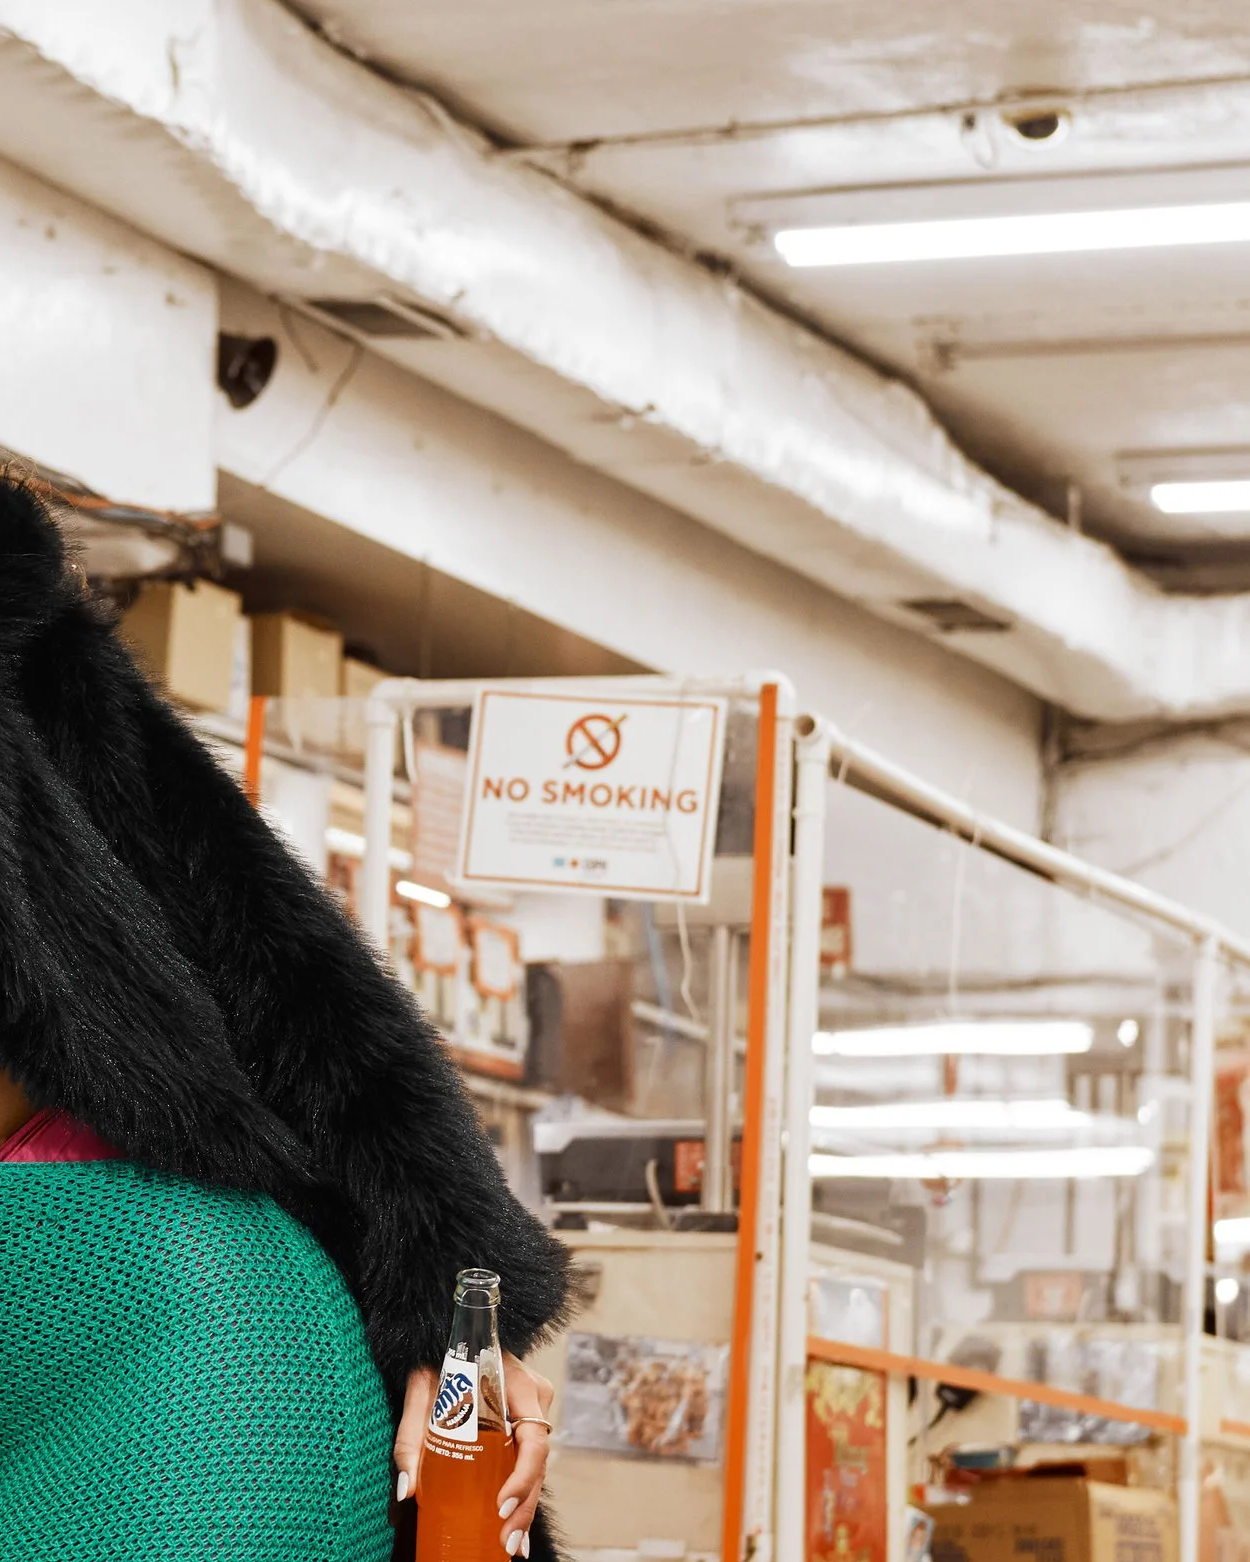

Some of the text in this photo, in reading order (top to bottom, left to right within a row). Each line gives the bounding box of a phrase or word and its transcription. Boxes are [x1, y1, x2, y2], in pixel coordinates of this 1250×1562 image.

[482, 776, 699, 814] NO SMOKING
[433, 1372, 473, 1420] anta
[455, 1444, 484, 1452] REFRESCO
